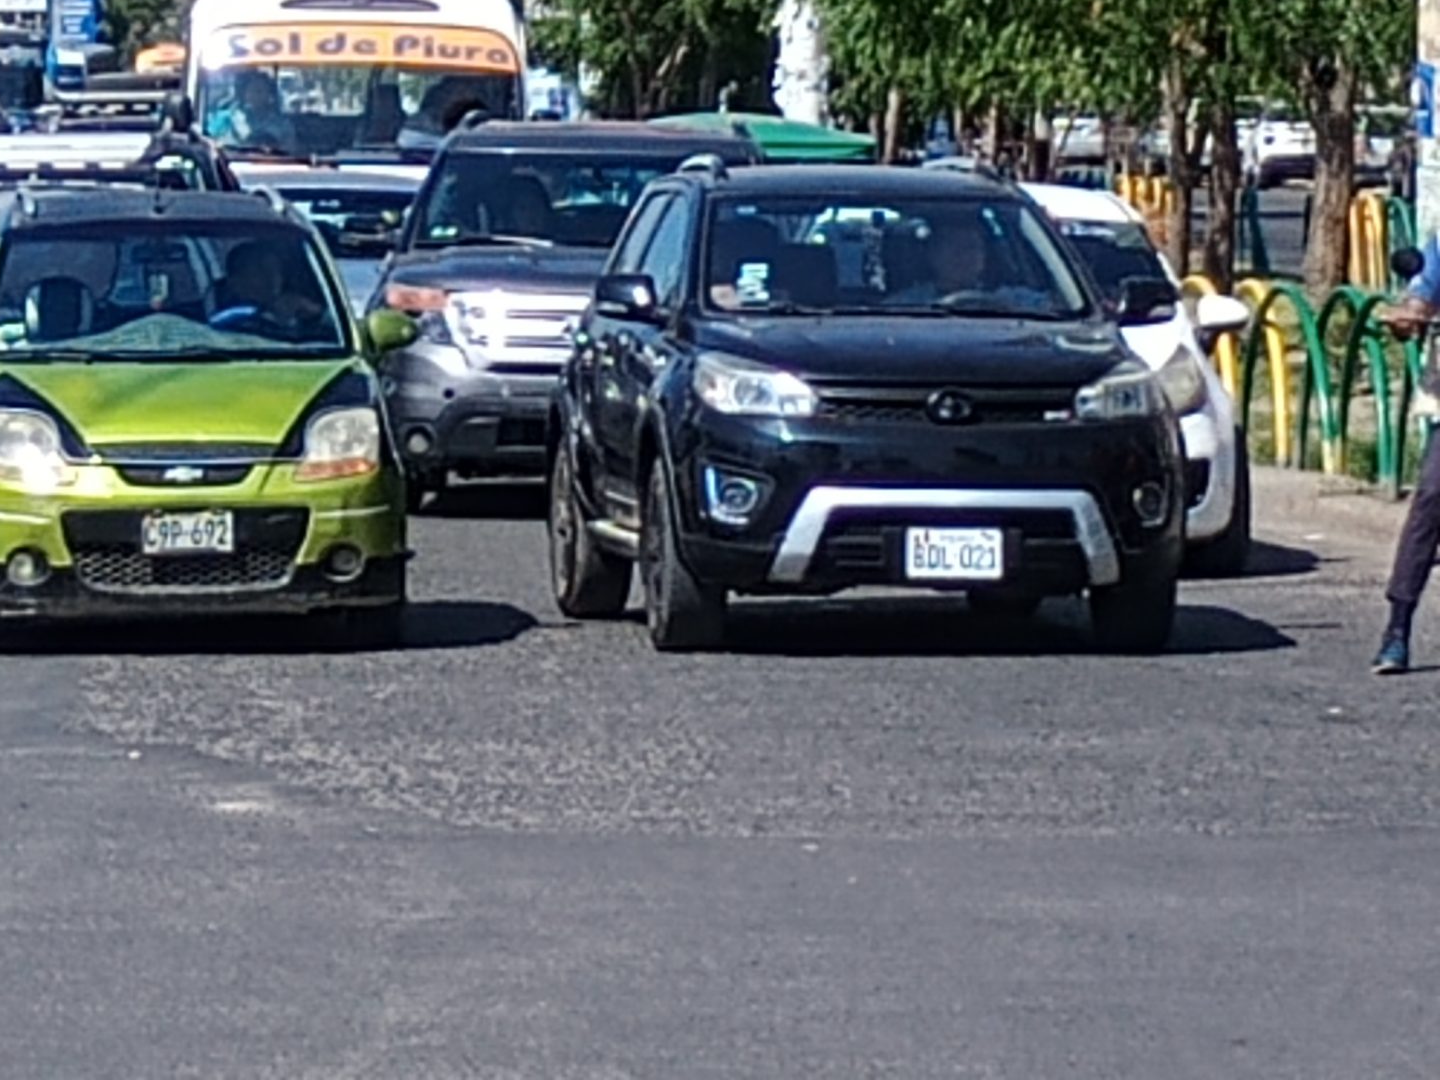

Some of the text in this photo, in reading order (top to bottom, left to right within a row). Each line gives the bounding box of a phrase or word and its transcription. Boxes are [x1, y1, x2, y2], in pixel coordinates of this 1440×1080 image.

[228, 32, 509, 64] Sol de Piura
